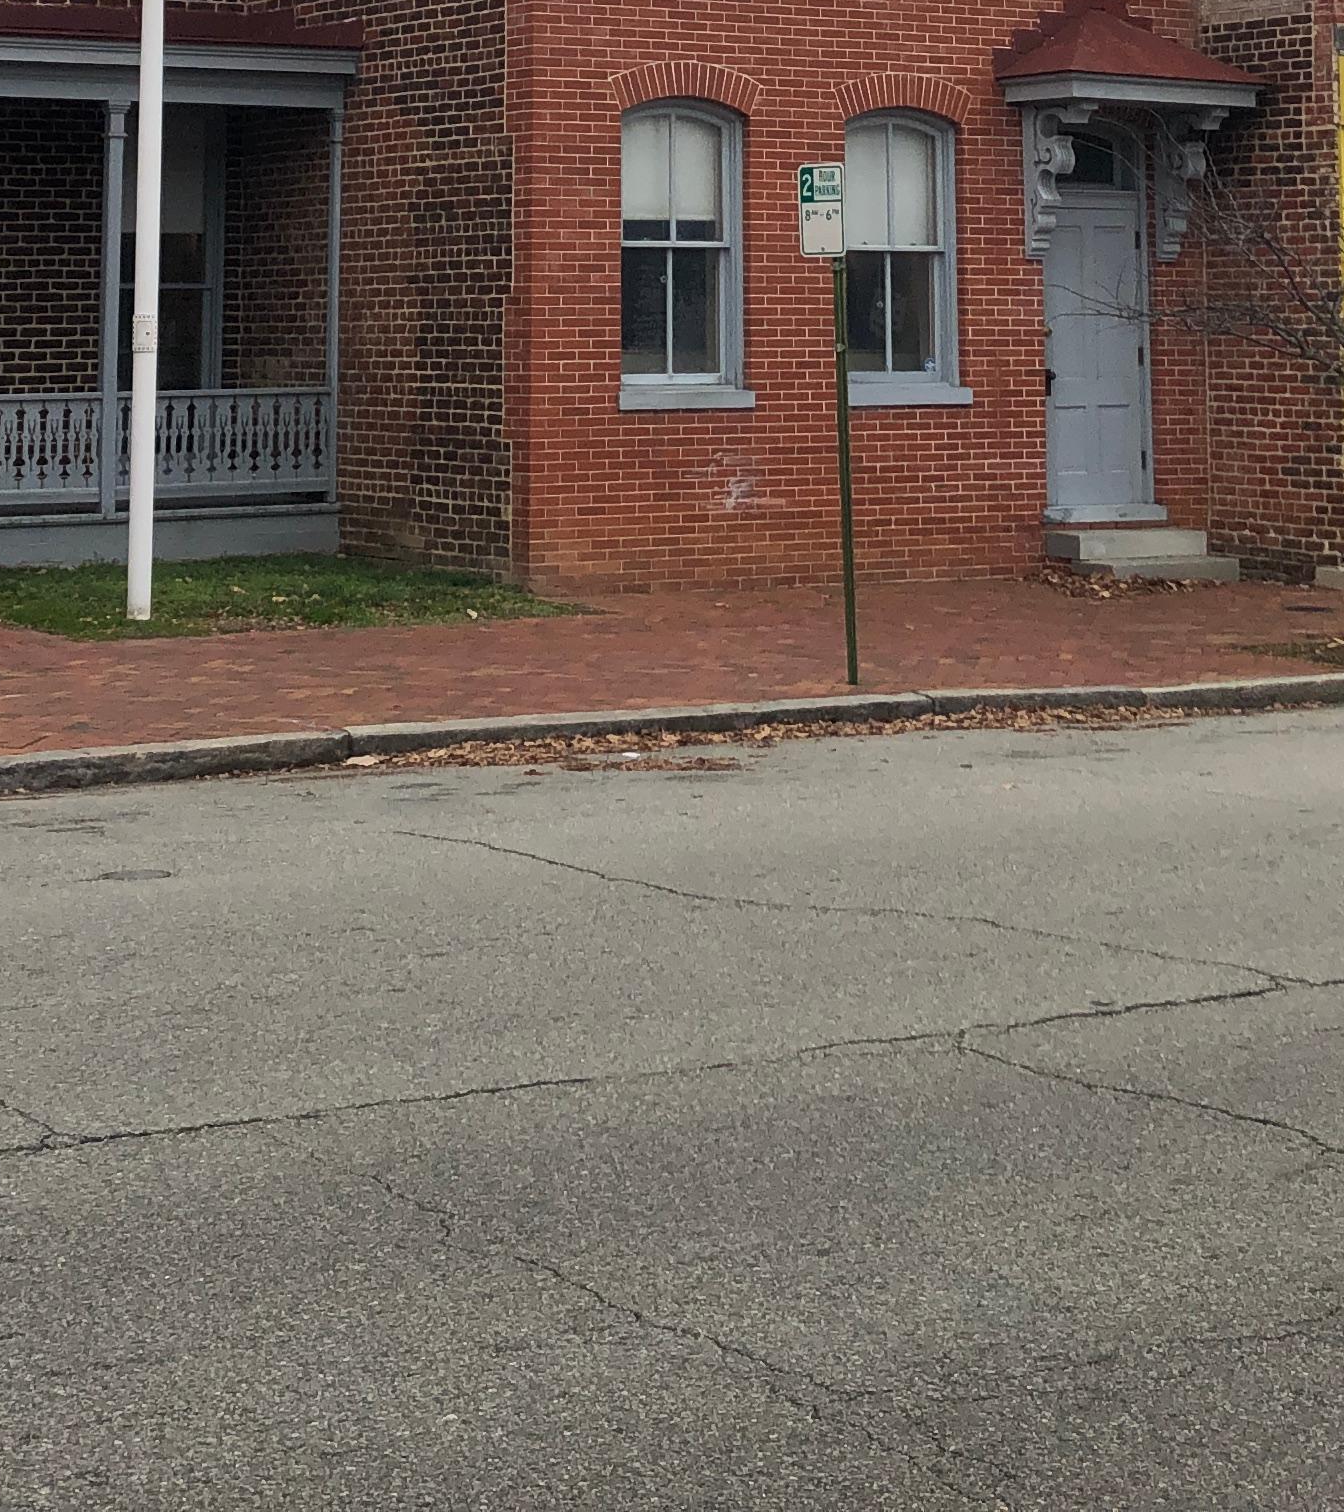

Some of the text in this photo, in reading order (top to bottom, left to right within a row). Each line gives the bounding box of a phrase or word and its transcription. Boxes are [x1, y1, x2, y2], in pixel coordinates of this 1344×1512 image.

[802, 170, 836, 196] 2 HOUR
[814, 184, 840, 196] PARKING
